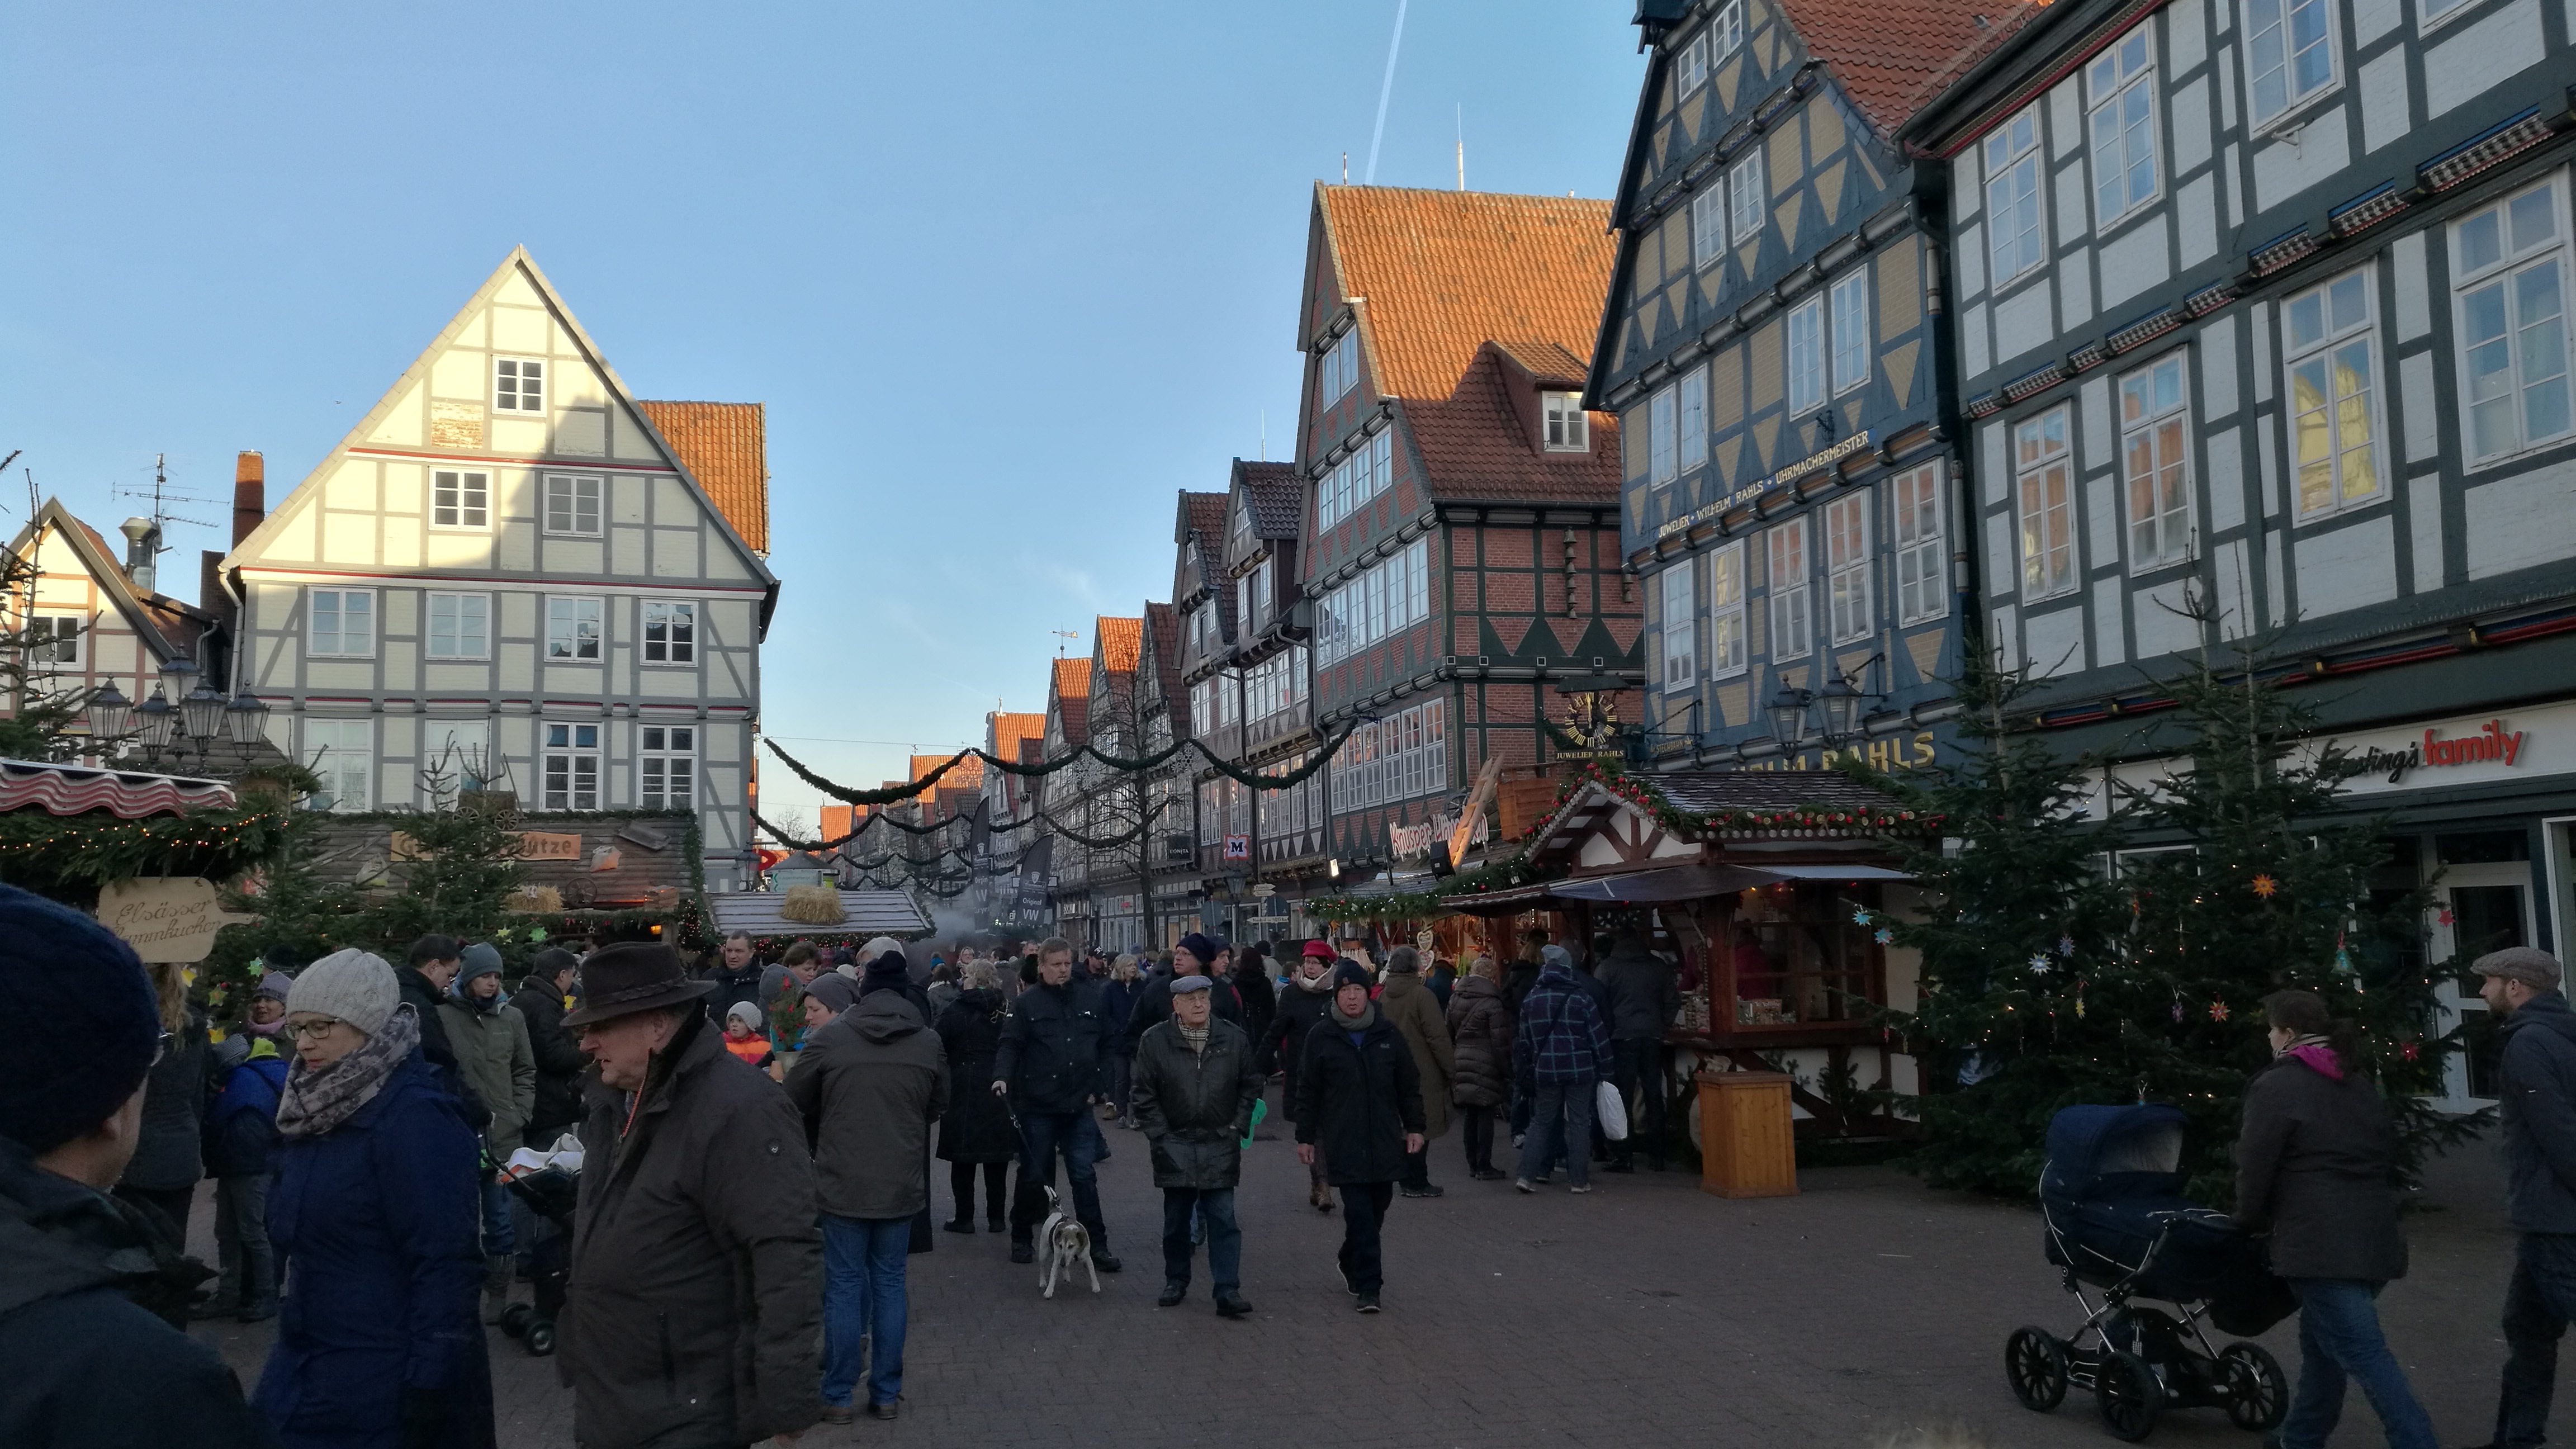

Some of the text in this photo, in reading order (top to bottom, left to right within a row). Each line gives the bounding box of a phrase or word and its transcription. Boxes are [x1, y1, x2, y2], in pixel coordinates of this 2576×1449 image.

[1659, 430, 1869, 538] JUWELIER WILHELM RAHLS UHRMACHERMEISTER
[2423, 719, 2522, 766] family
[1389, 822, 1432, 859] Knusper
[116, 899, 212, 926] Elsässer
[1022, 897, 1042, 906] Original
[1023, 908, 1039, 921] VW
